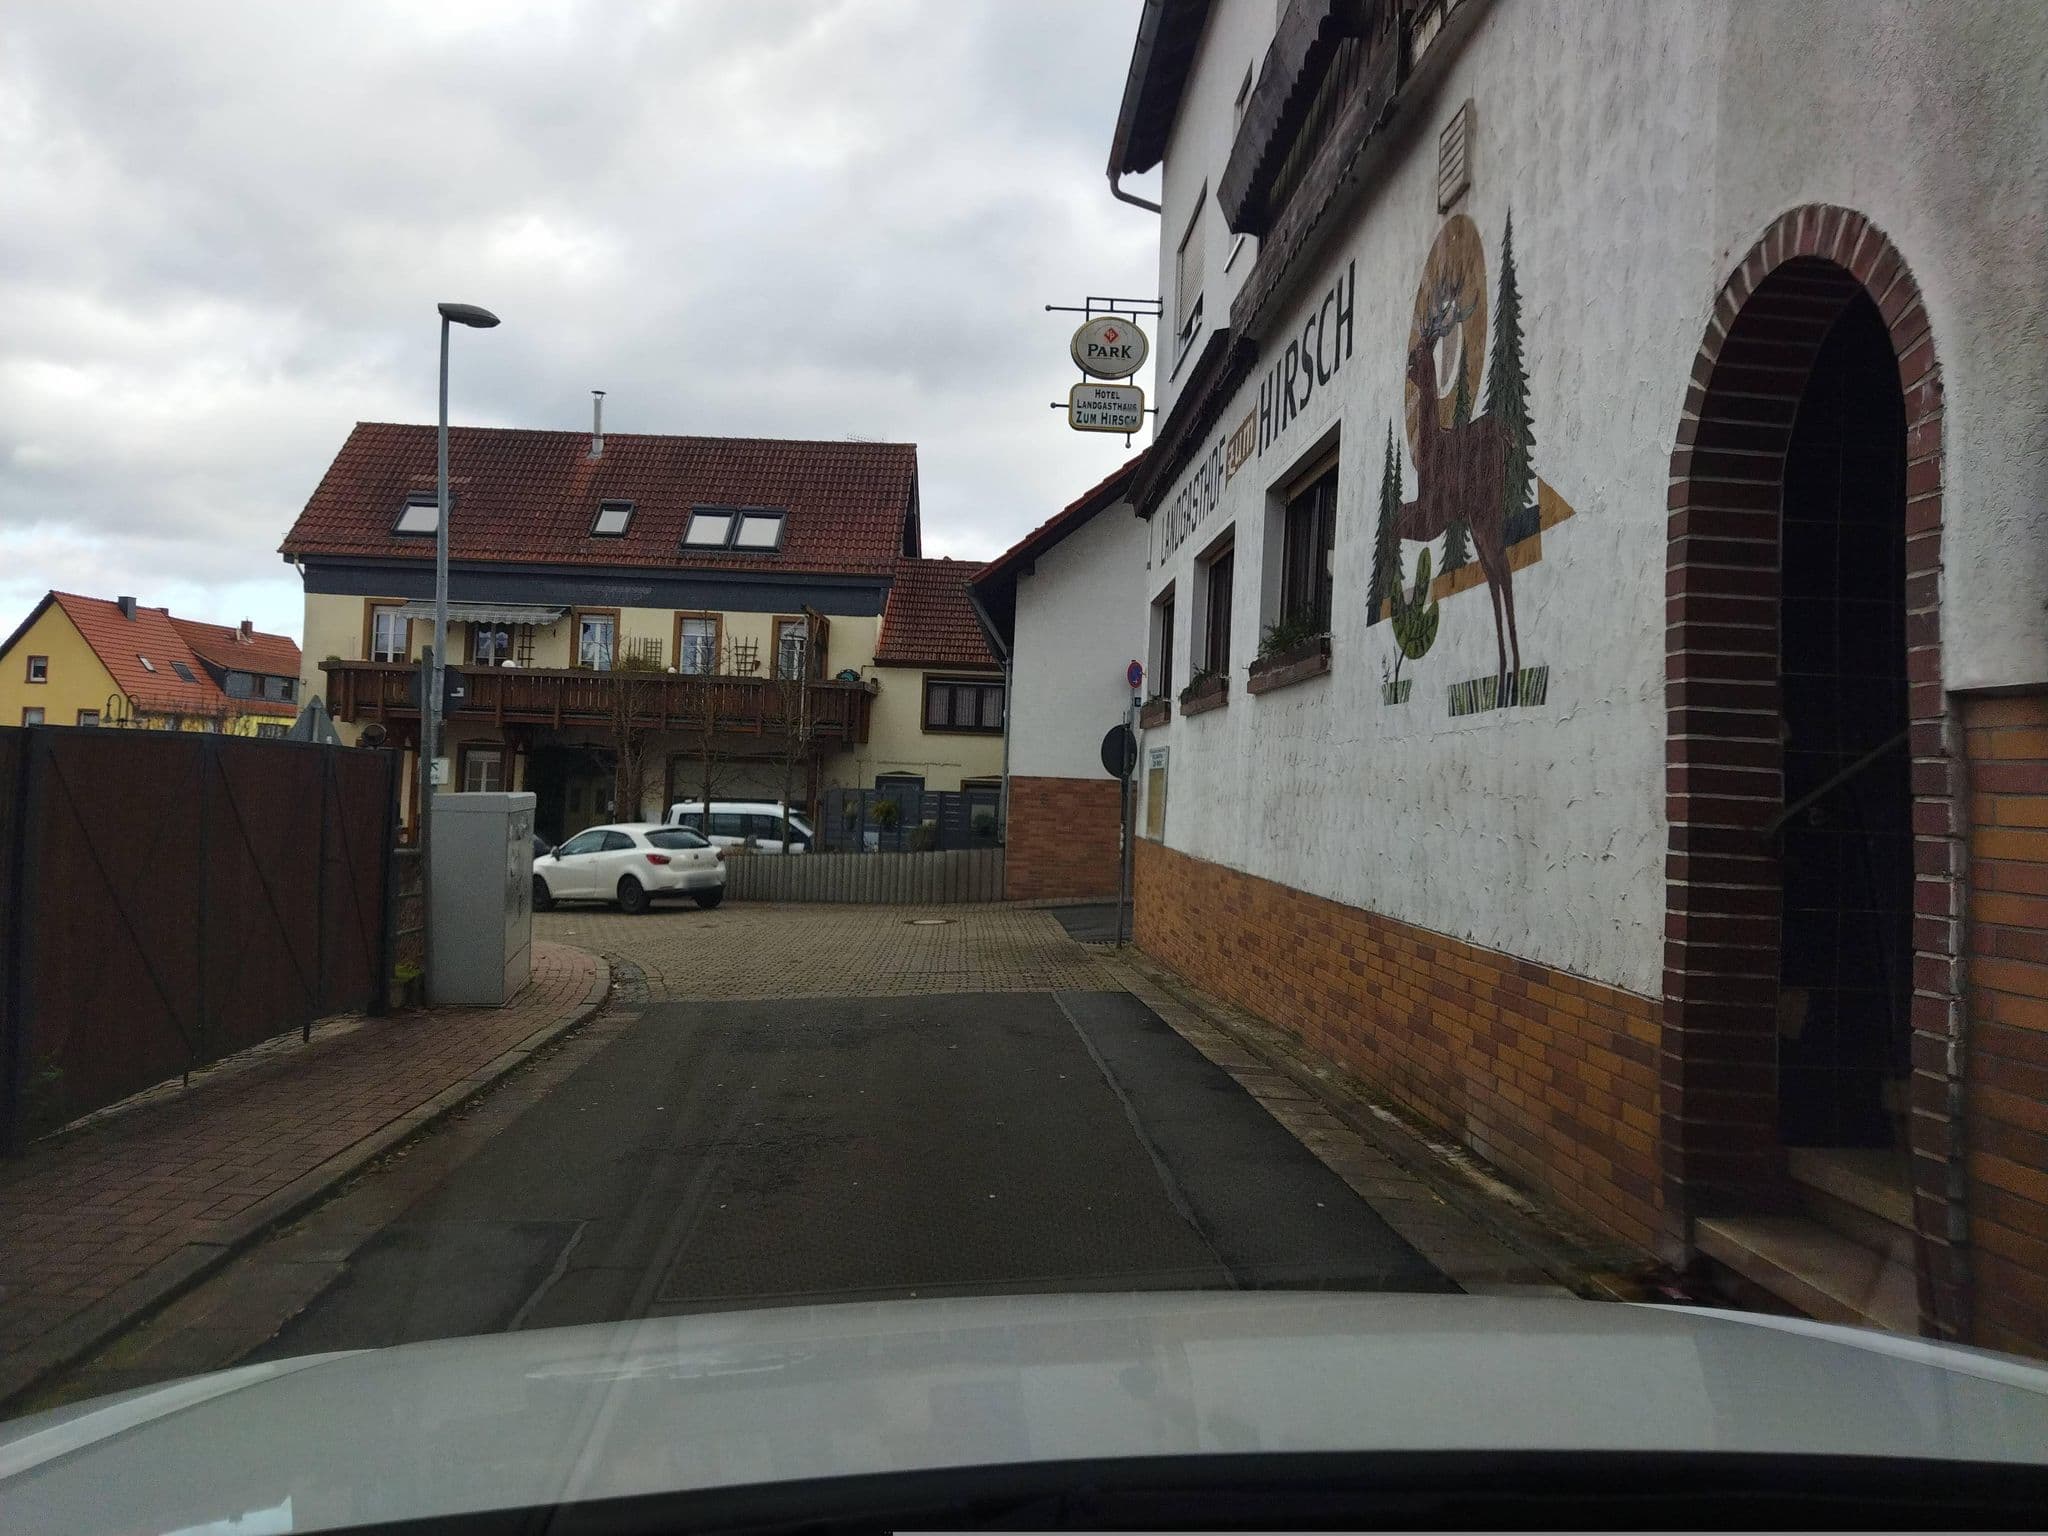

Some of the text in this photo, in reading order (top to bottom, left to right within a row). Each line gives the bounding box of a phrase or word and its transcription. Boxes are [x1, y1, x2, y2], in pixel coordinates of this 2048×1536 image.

[1088, 343, 1132, 359] PARK
[1095, 389, 1120, 399] HOTEL
[1076, 411, 1137, 426] ZUM HIRSCH
[1160, 435, 1226, 568] LANDGASTHOF
[1258, 258, 1356, 458] HIRSCH
